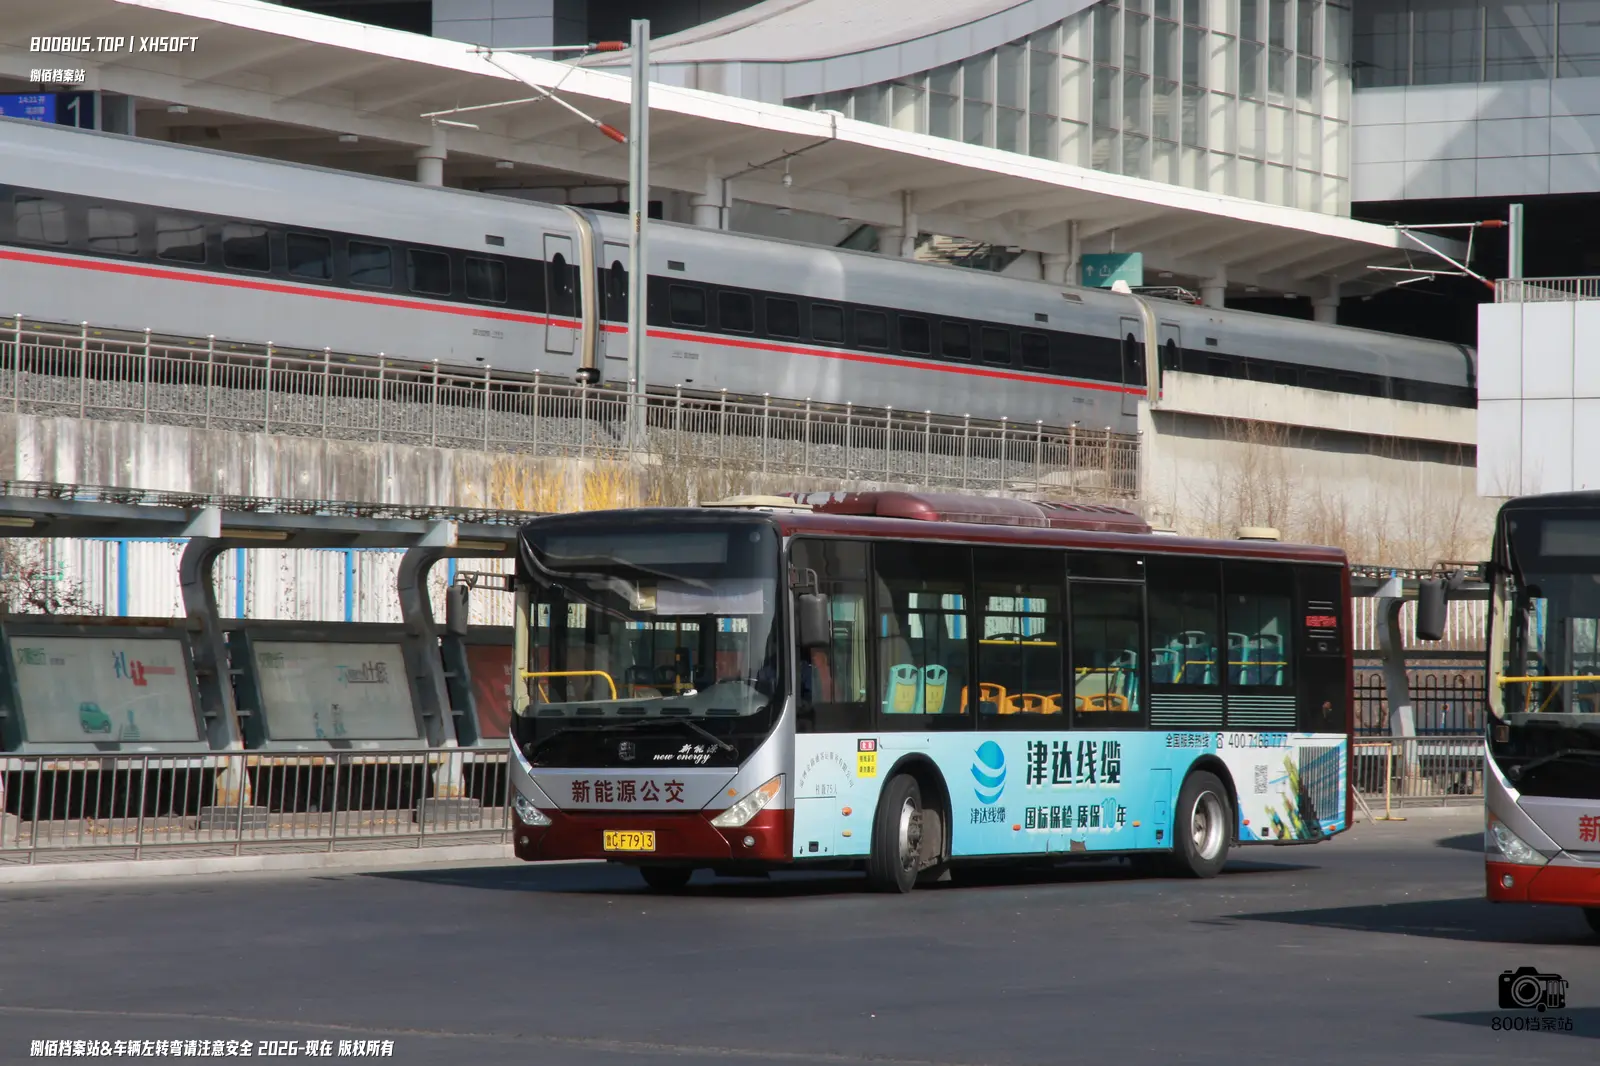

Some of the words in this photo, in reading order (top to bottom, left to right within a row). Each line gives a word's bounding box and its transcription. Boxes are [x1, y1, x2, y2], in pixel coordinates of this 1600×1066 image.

[1228, 733, 1246, 749] 400
[653, 753, 675, 761] new
[676, 752, 711, 765] energy
[1026, 740, 1121, 785] 津达线缆
[571, 779, 685, 804] 新能源公交
[970, 806, 1006, 825] 津达线缆
